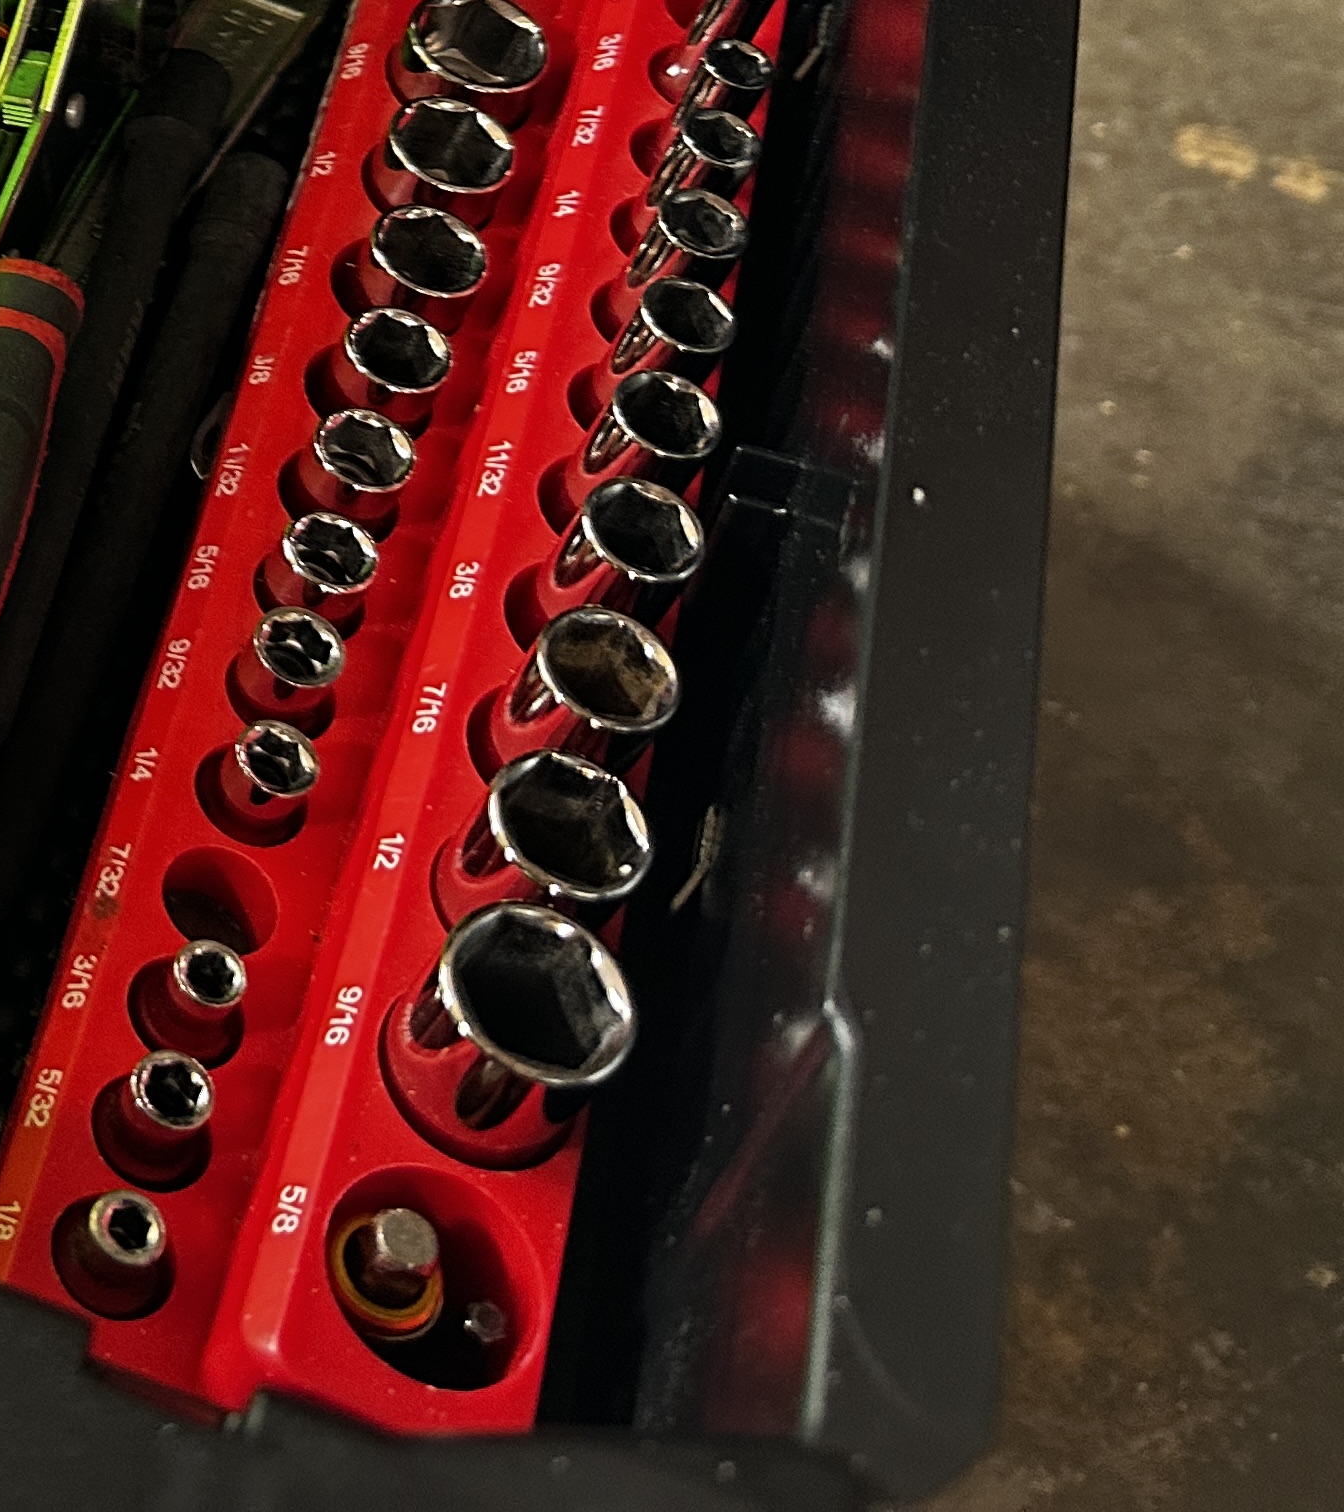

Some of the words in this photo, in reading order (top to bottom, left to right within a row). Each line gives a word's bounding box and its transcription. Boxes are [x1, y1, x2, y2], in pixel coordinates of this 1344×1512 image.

[477, 439, 512, 497] 11/32
[188, 544, 219, 590] 5/16
[449, 560, 481, 600] 3/8
[412, 681, 448, 735] 7/16
[129, 746, 159, 782] 1/4
[372, 832, 406, 871] 1/2
[61, 954, 99, 1011] 3/16
[324, 985, 363, 1047] 9/16
[23, 1068, 64, 1128] 5/32
[270, 1183, 309, 1236] 5/8
